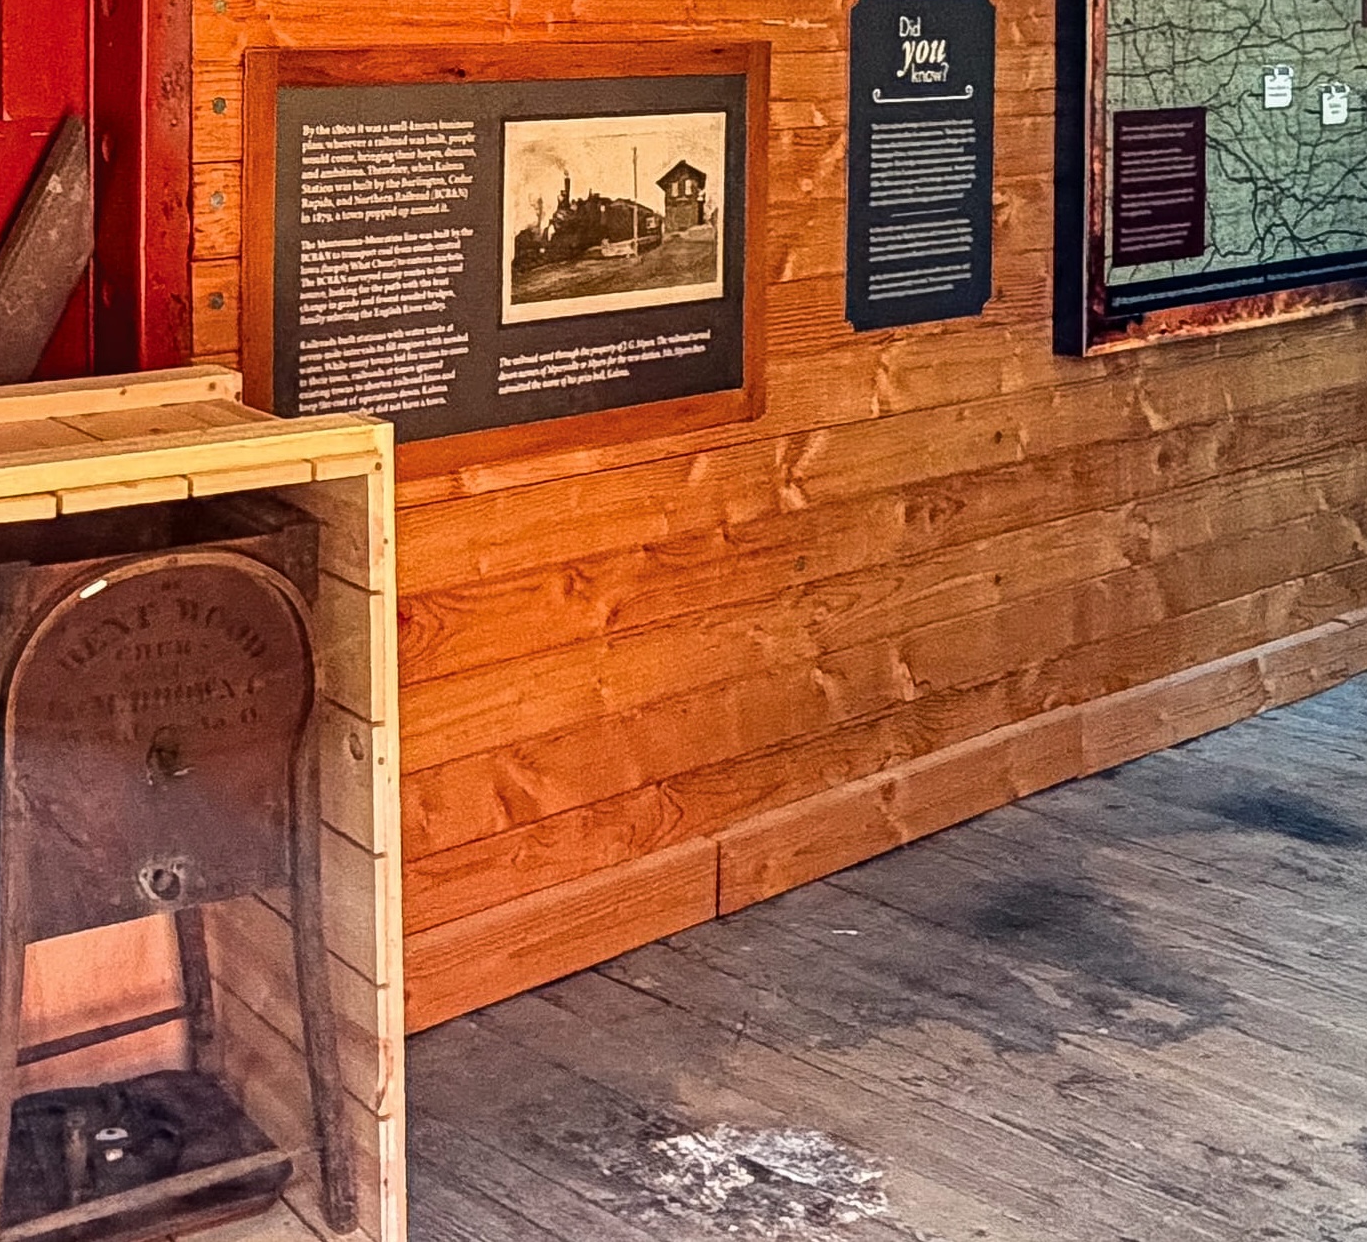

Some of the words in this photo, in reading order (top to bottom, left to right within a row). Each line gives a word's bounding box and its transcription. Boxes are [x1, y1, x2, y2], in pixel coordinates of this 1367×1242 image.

[899, 16, 921, 37] Did
[896, 38, 947, 77] you
[910, 63, 949, 83] know?
